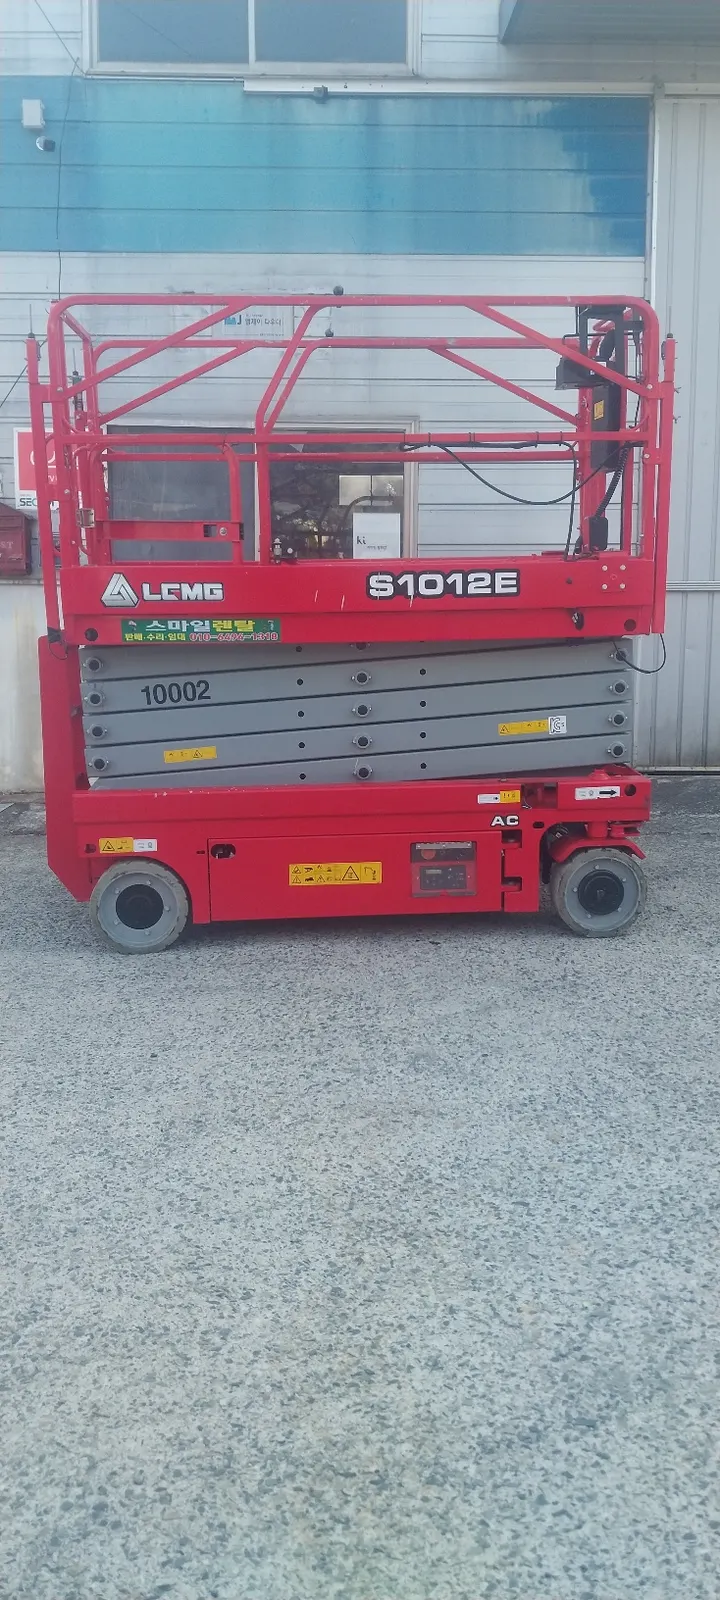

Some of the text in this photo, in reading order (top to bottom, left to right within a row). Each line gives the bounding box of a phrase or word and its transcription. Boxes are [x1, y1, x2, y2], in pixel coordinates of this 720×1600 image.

[368, 571, 519, 598] S1012E
[140, 680, 212, 706] 10002
[491, 815, 519, 826] AC
